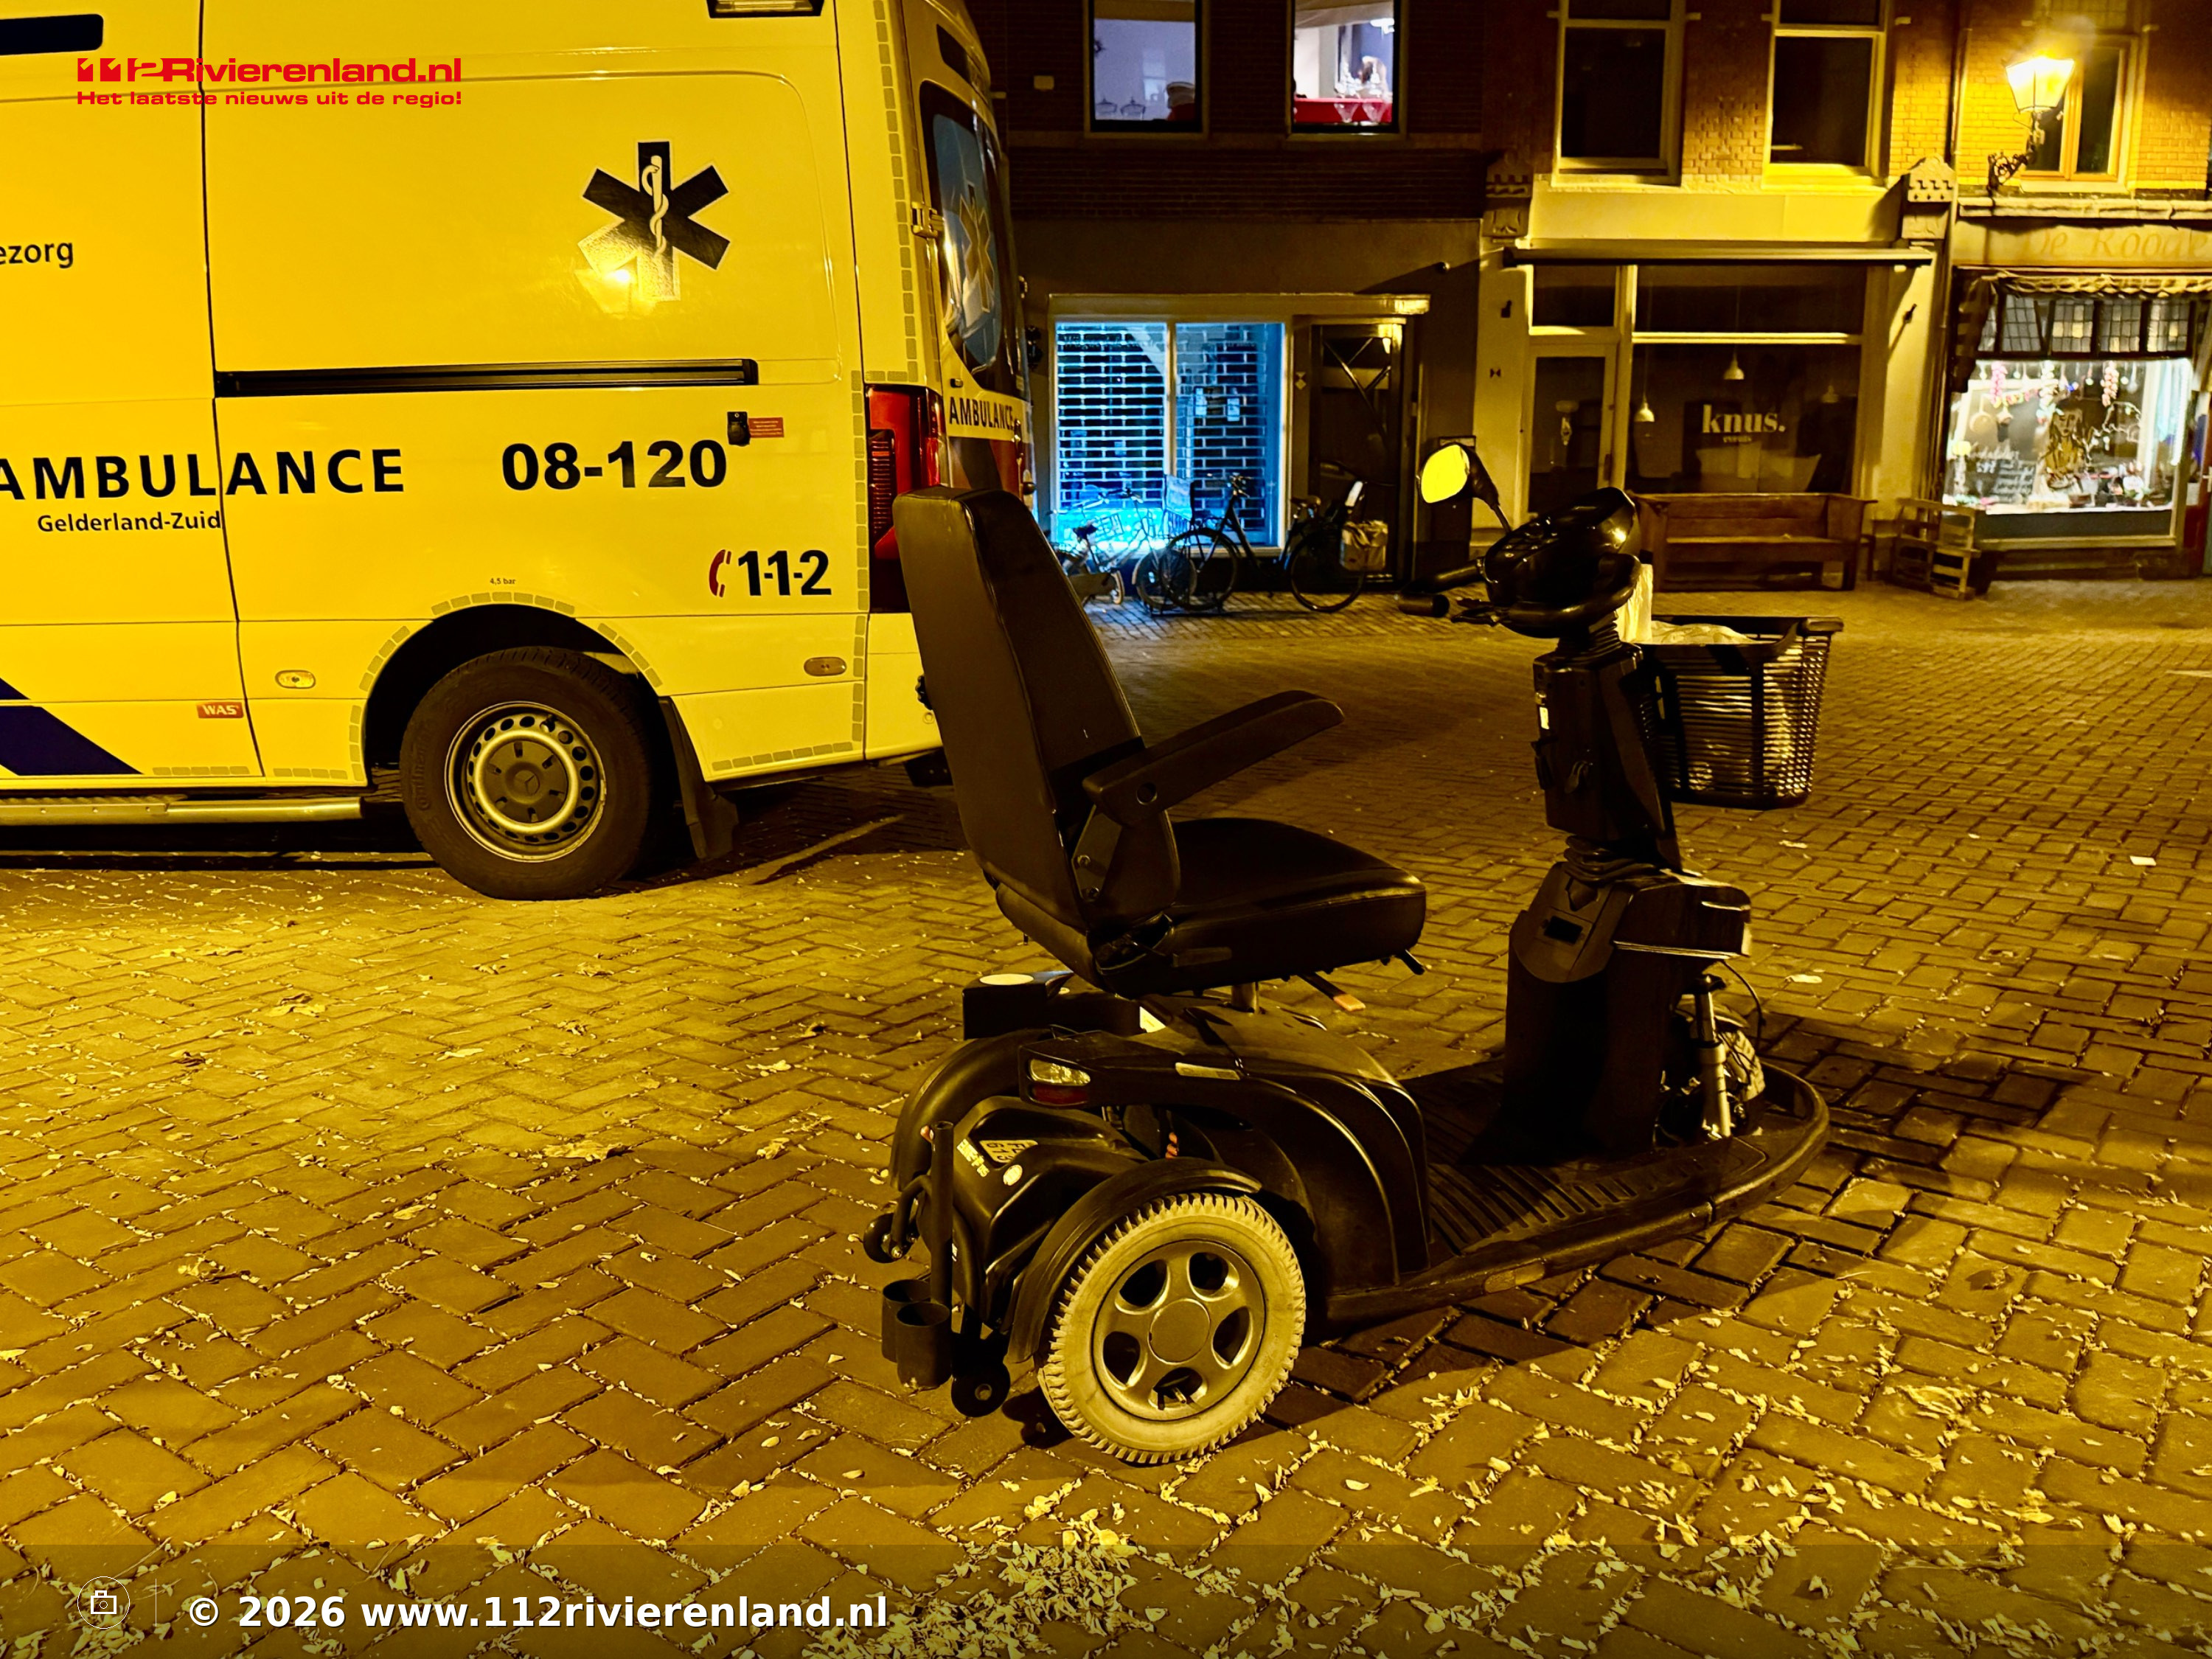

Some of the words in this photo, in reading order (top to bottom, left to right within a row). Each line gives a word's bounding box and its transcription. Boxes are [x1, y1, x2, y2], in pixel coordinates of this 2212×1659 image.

[949, 396, 1014, 431] AMBULANCE
[1702, 404, 1786, 433] knus.
[0, 448, 404, 500] AMBULANCE
[503, 440, 727, 491] 08-120
[38, 510, 223, 532] Gelderland-Zuid
[738, 549, 832, 596] 1-1-2
